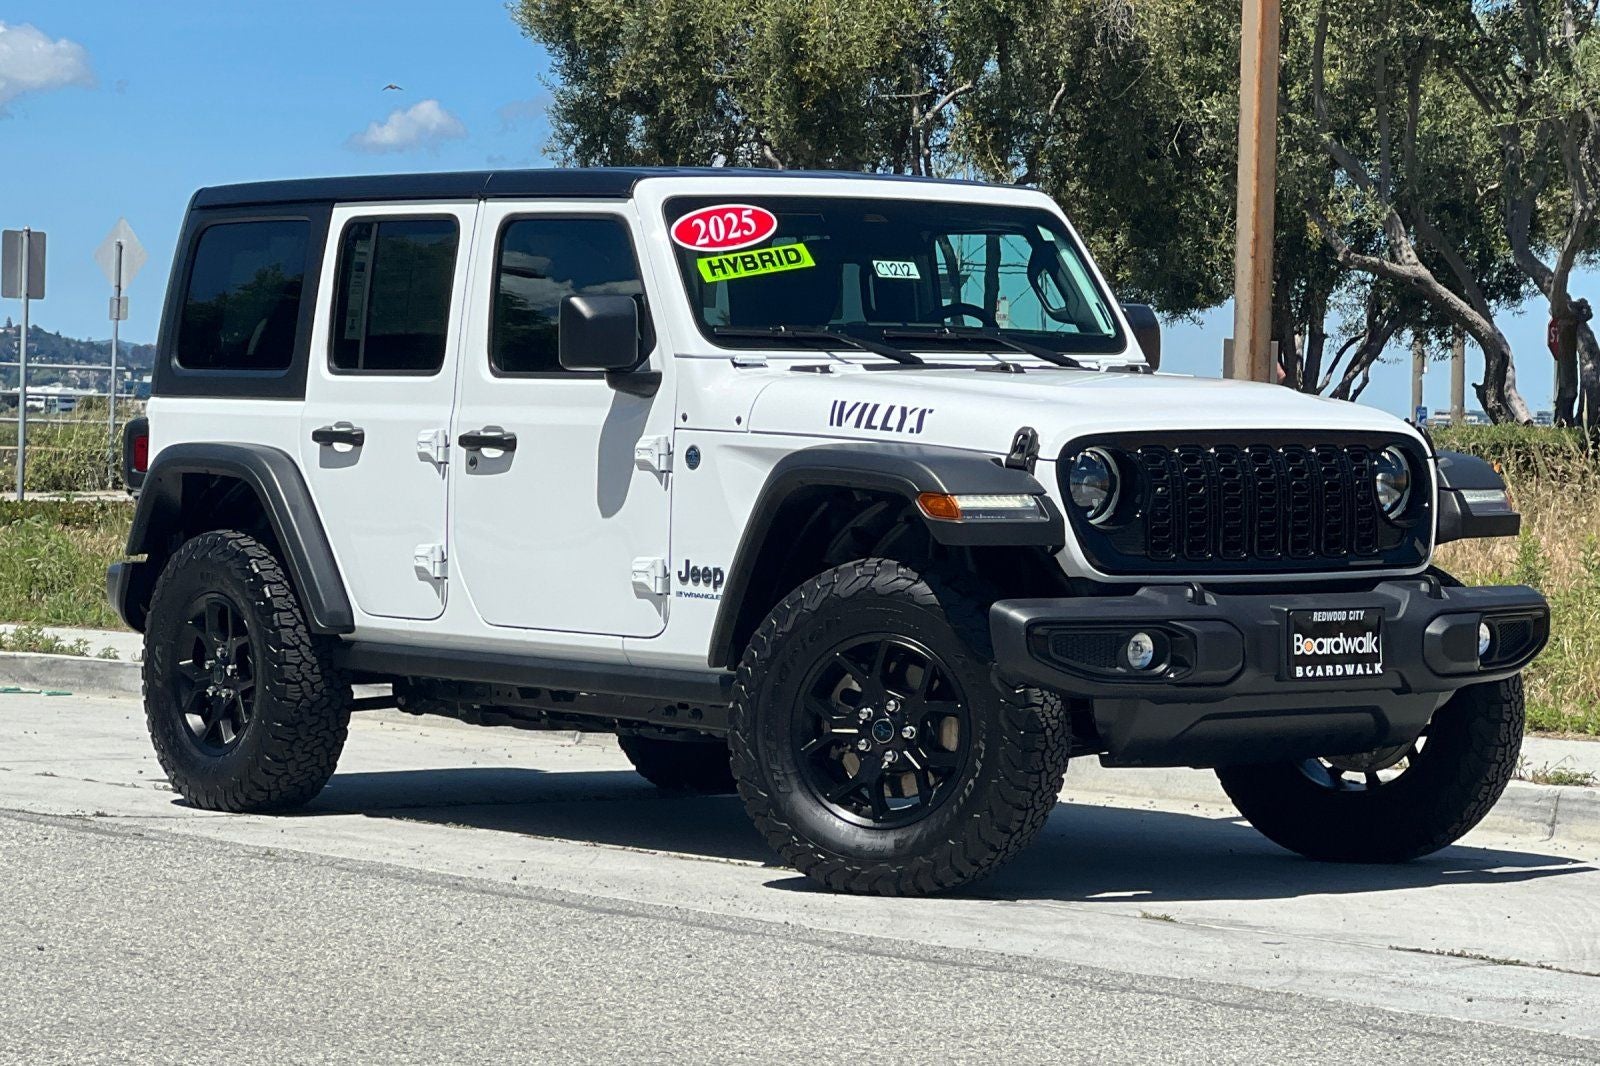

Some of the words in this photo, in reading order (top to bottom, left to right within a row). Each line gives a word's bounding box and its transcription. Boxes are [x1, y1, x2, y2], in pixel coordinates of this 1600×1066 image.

[692, 209, 756, 245] 2025
[707, 247, 804, 277] HYBRID
[829, 399, 934, 434] WILLYS
[678, 559, 724, 590] Jeep
[683, 591, 722, 600] WRANGLE
[1313, 611, 1346, 621] REDWOOD
[1349, 610, 1365, 620] CITY
[1293, 631, 1379, 655] Boardwalk
[1295, 662, 1383, 677] BOARDWALK
